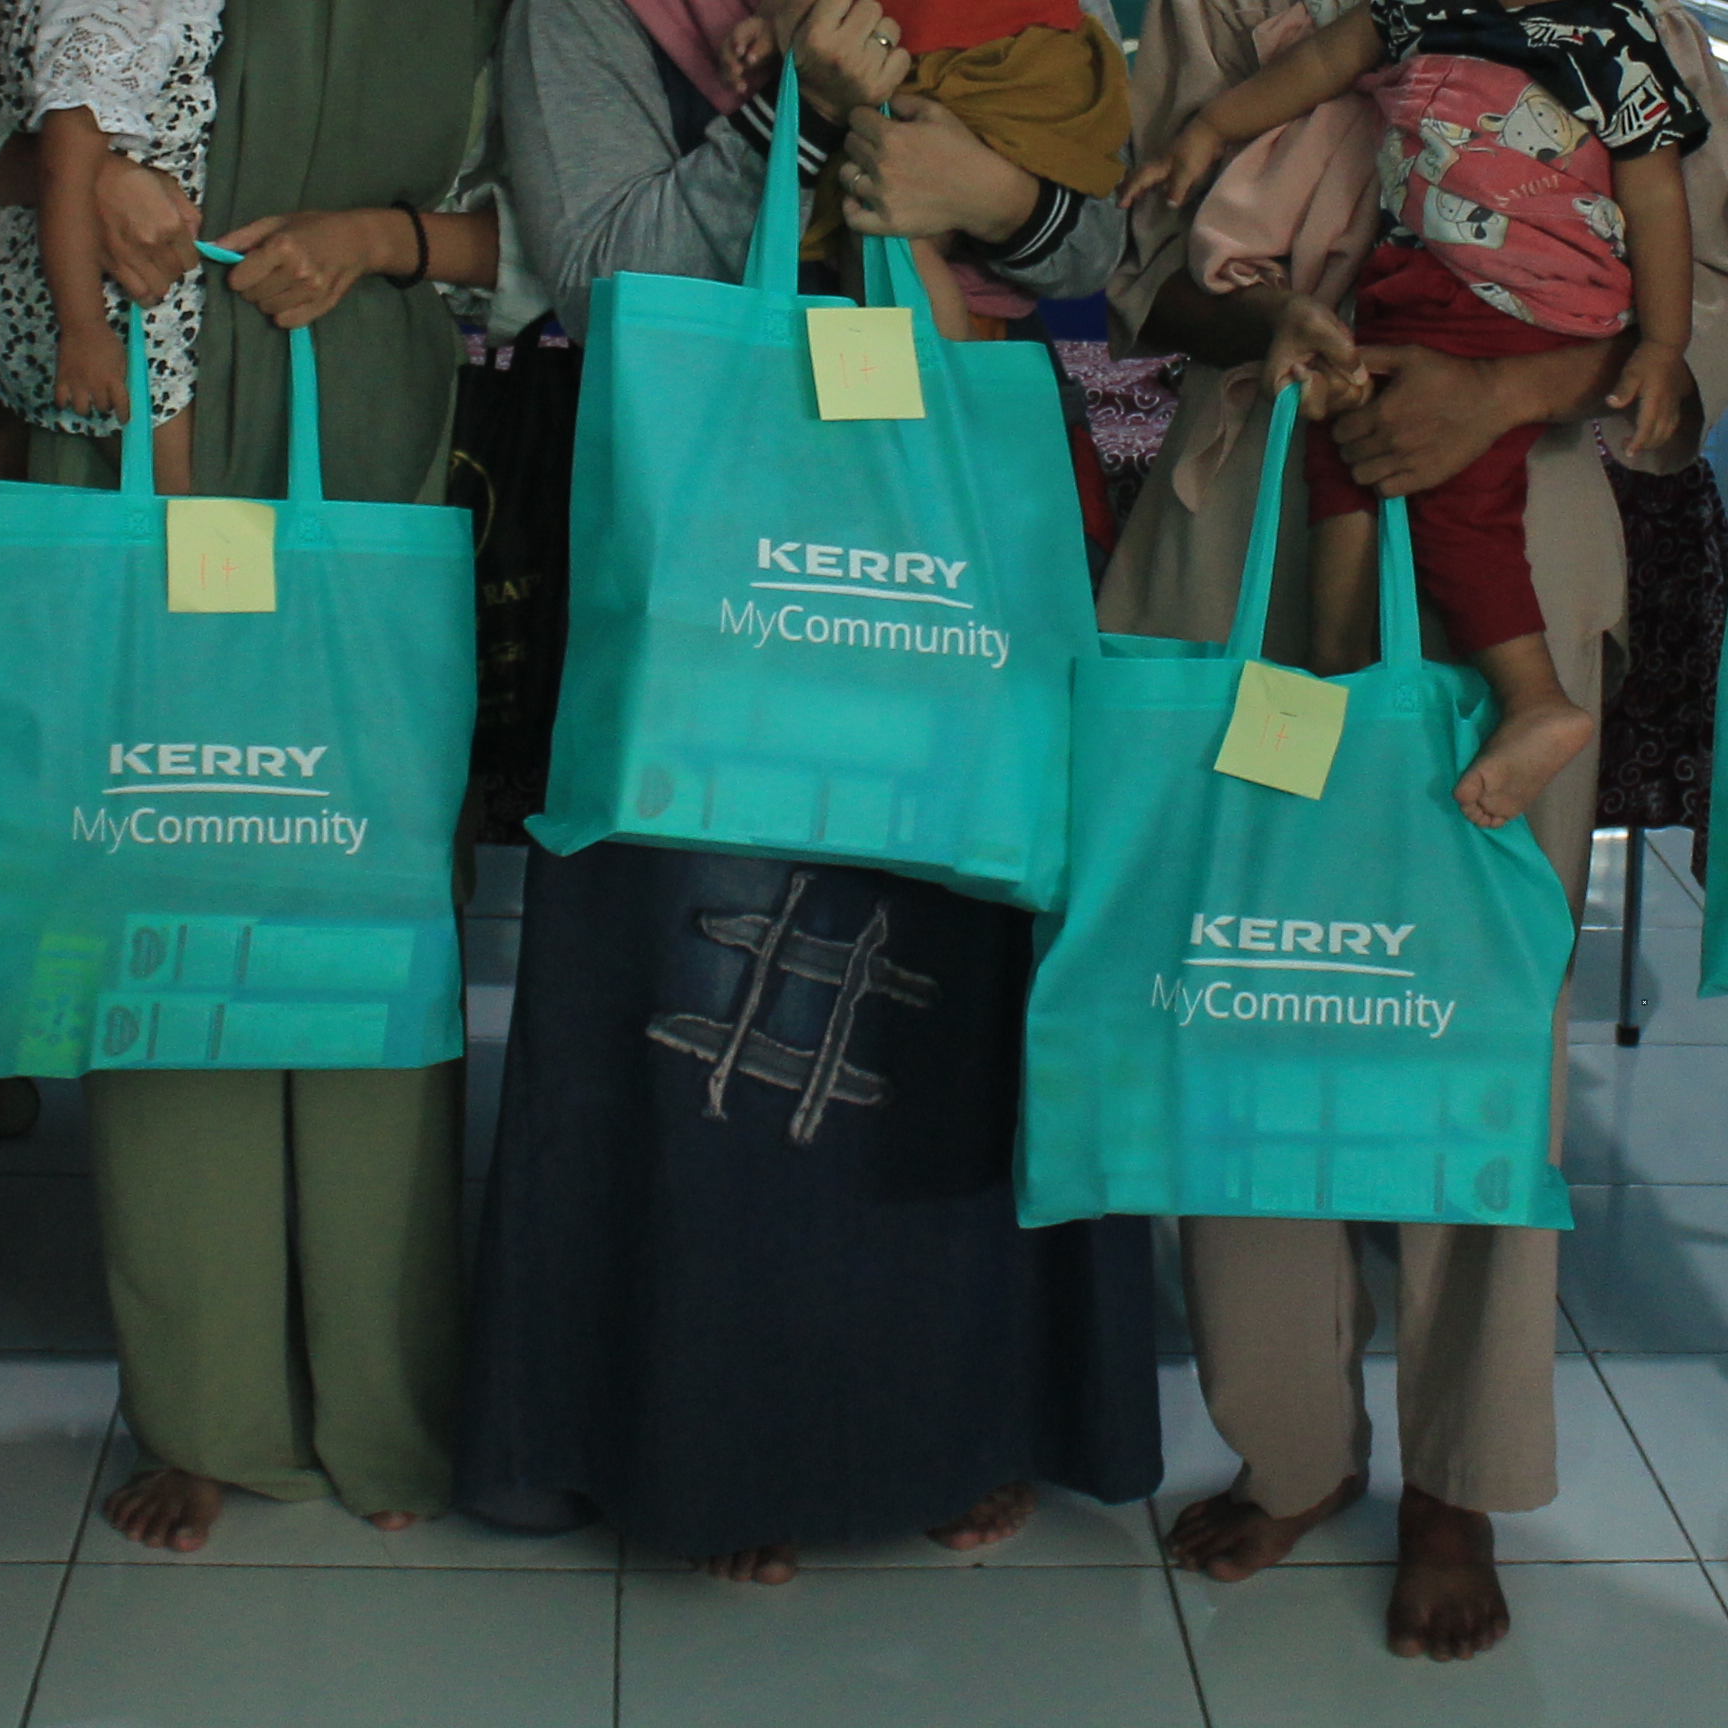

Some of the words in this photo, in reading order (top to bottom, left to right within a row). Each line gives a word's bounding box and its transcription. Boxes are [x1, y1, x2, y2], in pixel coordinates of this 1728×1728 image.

[756, 537, 969, 590] KERRY
[719, 597, 1011, 670] MyCommunity
[108, 742, 329, 779] KERRY
[72, 805, 369, 856] MyCommunity
[1189, 913, 1417, 957] KERRY
[1151, 973, 1458, 1040] MyCommunity
